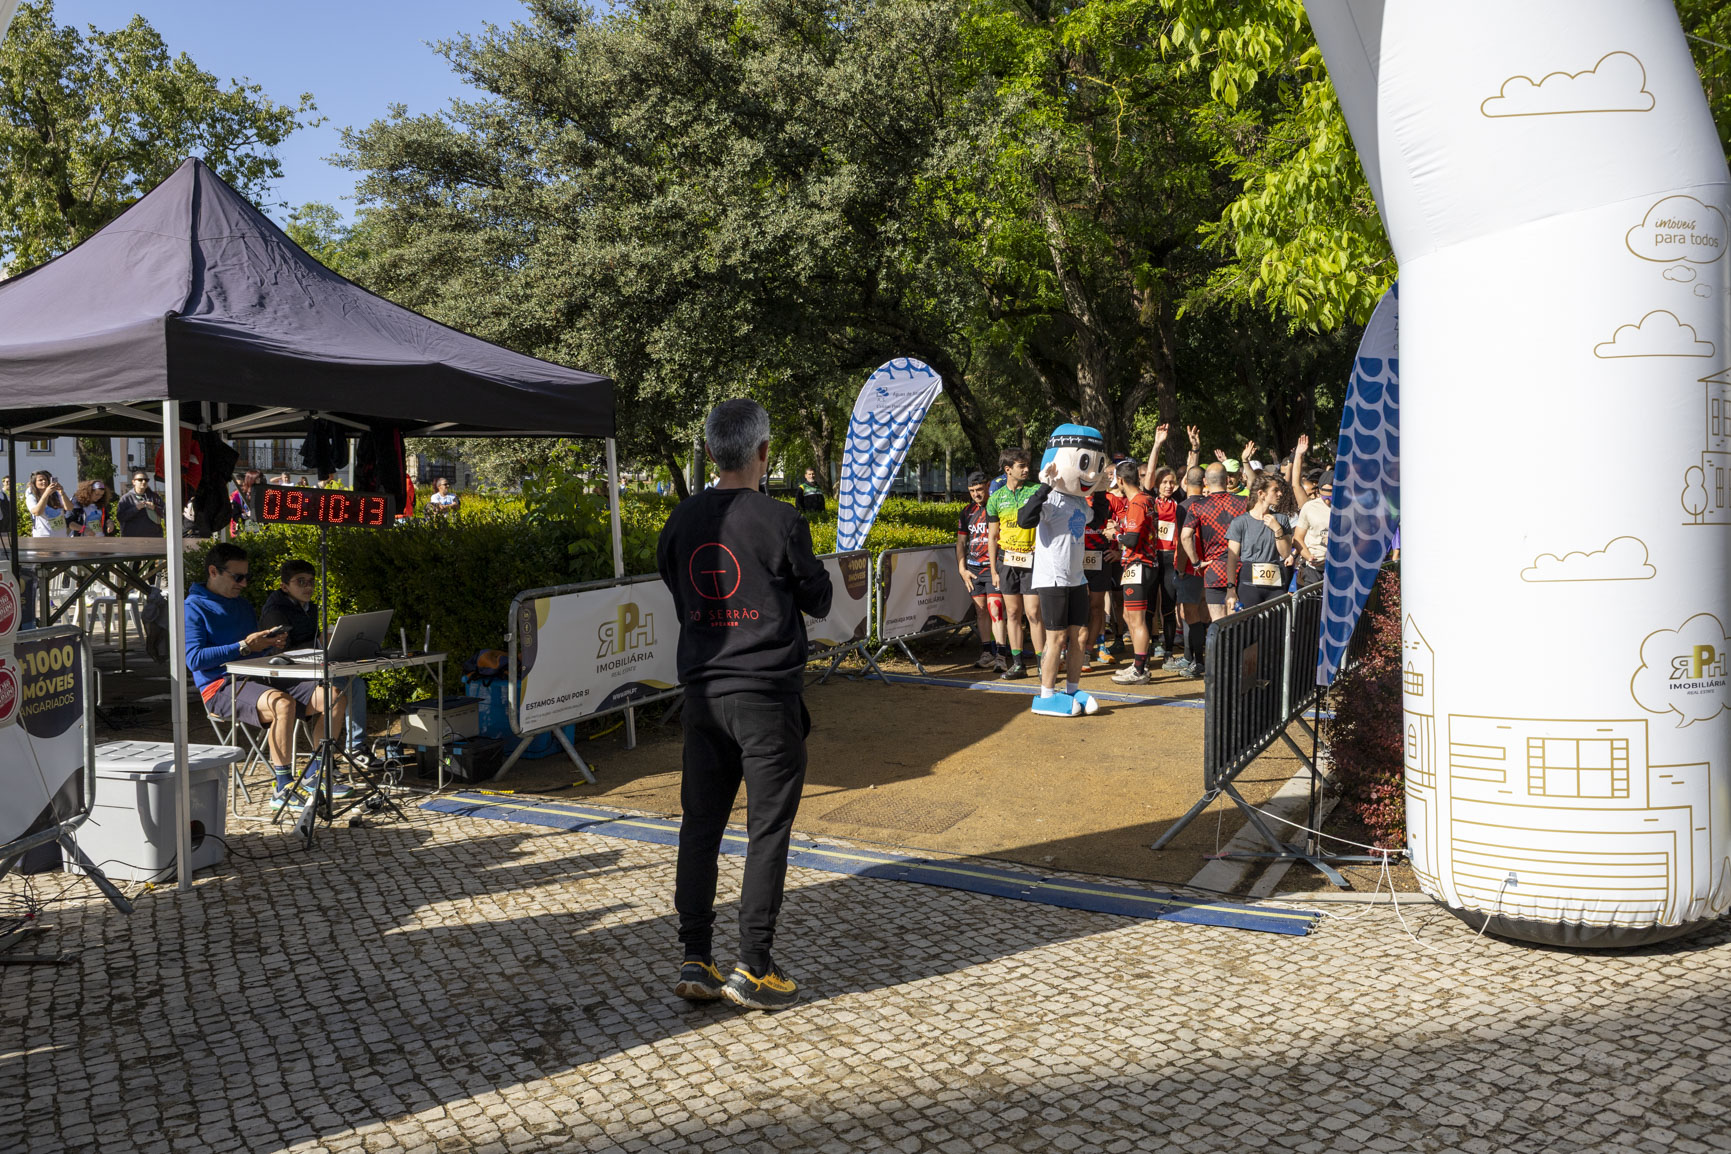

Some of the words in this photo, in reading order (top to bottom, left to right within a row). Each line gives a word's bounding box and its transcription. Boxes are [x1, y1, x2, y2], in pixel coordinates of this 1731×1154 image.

[1655, 217, 1697, 230] imóveis
[1655, 233, 1686, 246] para
[1690, 233, 1719, 248] todos
[263, 489, 384, 525] 09:10:13
[1010, 555, 1027, 563] 186
[1259, 569, 1276, 578] 207
[708, 608, 759, 620] SERRÃO
[20, 644, 74, 676] +1000
[596, 651, 654, 674] IMOBILIÁRIA
[22, 672, 75, 701] MÓVEIS
[1669, 680, 1726, 690] IMOBILIÁRIA
[20, 692, 75, 718] ANGARIADOS
[525, 697, 556, 711] ESTAMOS
[556, 693, 571, 704] AQUI
[571, 690, 583, 700] POR
[584, 688, 590, 696] SI
